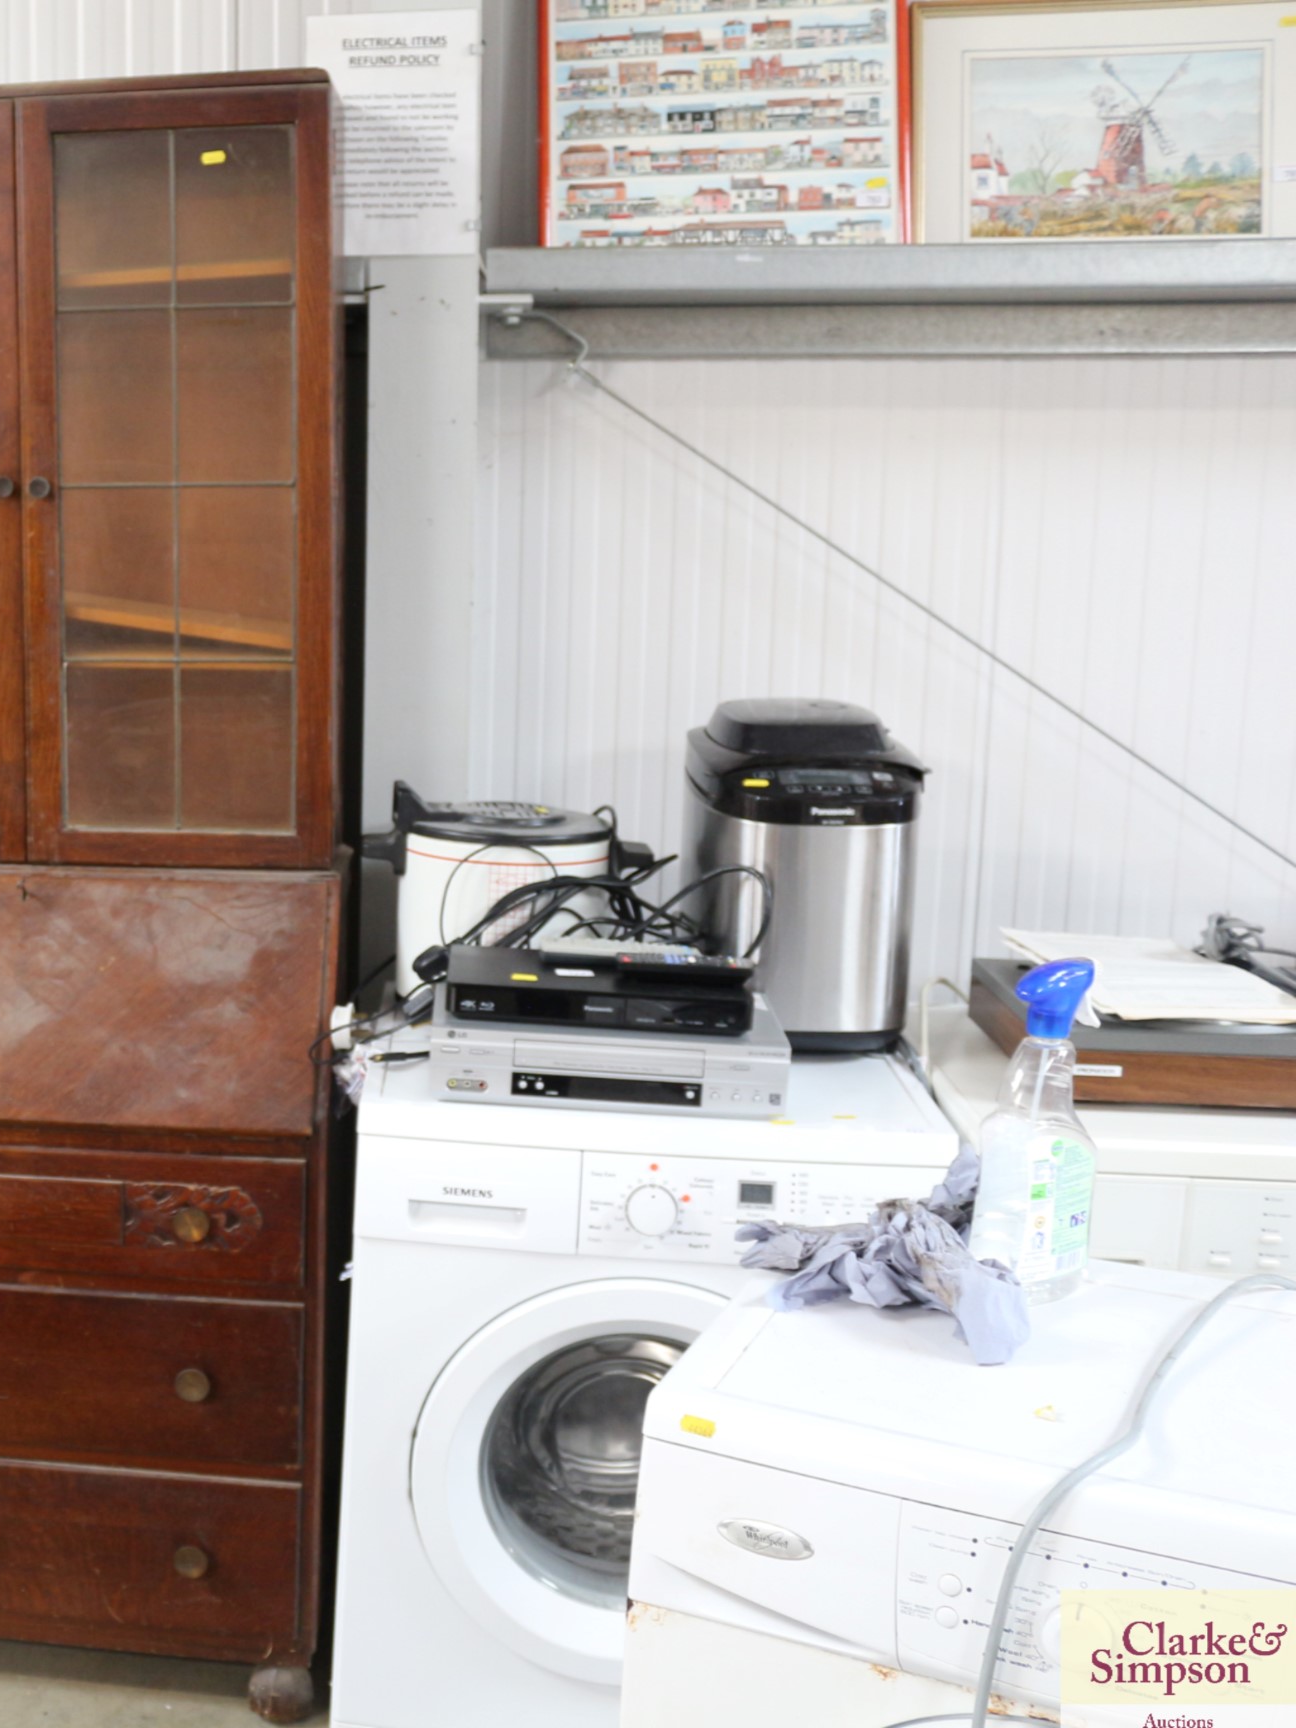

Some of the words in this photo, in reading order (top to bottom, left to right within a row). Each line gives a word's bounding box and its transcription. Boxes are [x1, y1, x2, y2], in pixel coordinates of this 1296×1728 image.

[342, 37, 408, 49] ELECTRICAL
[411, 35, 448, 48] ITEMS
[349, 55, 397, 66] REFUND
[399, 53, 441, 65] POLICY
[442, 1186, 494, 1199] SIEMENS
